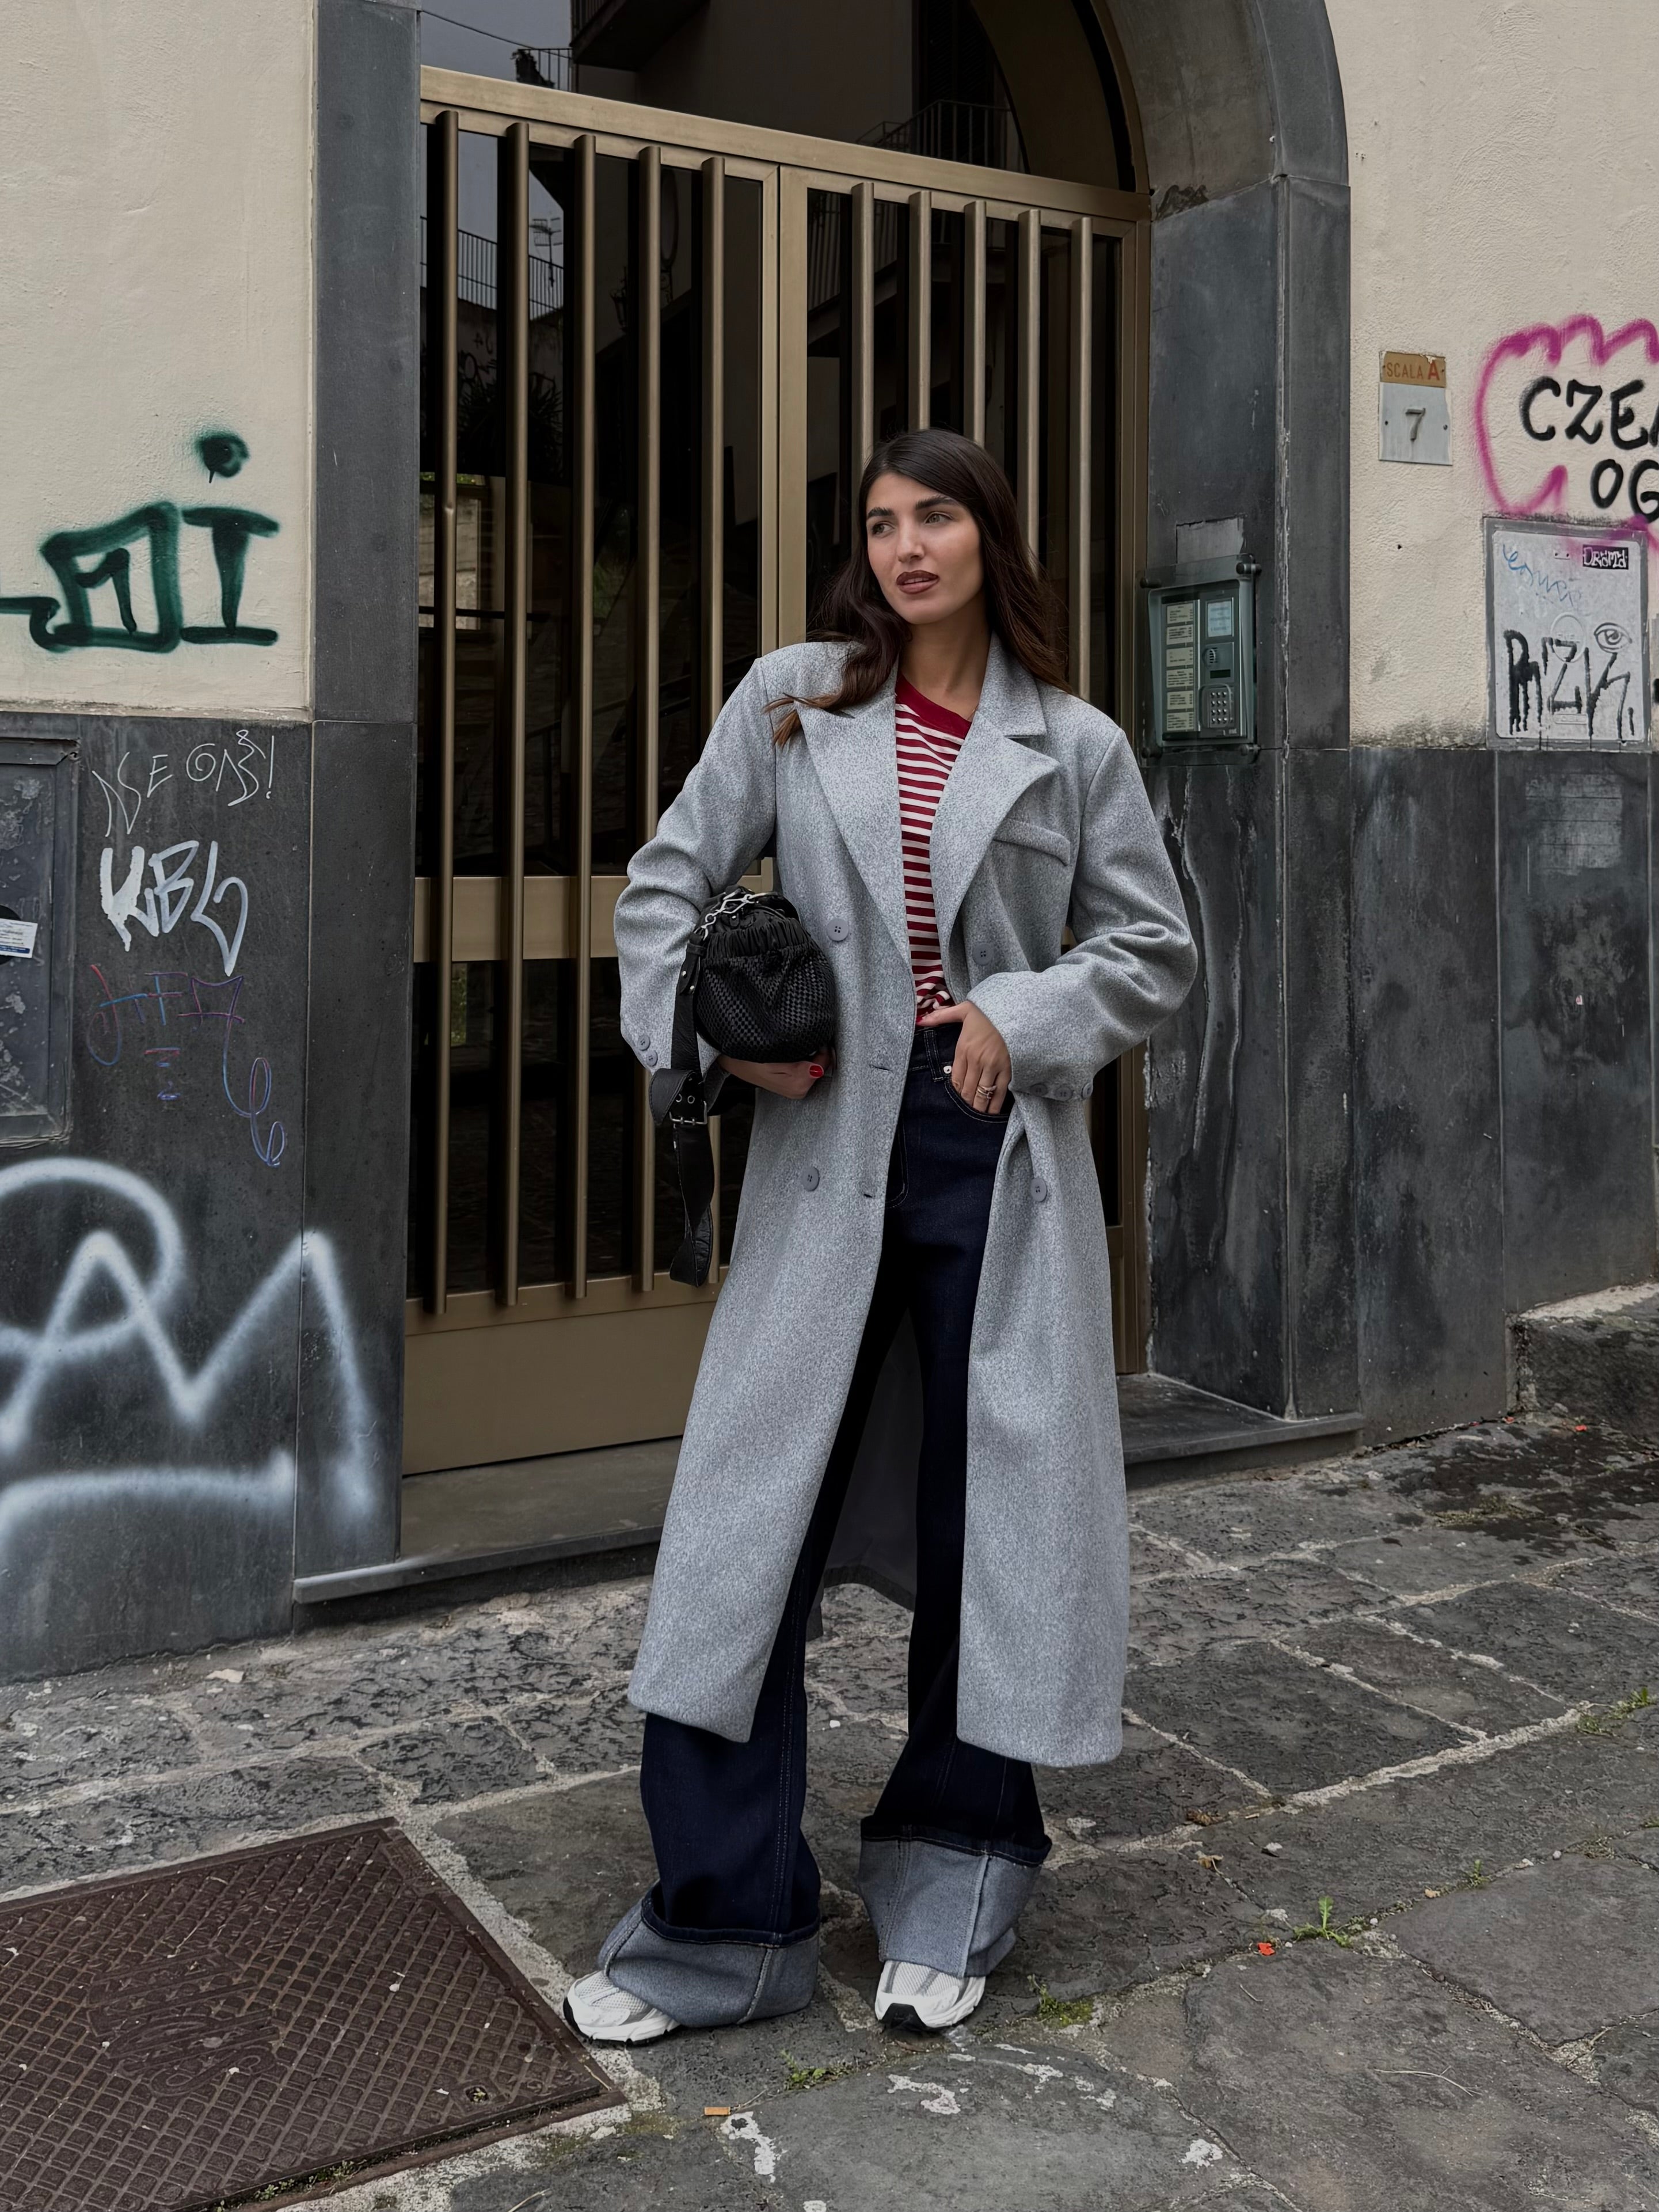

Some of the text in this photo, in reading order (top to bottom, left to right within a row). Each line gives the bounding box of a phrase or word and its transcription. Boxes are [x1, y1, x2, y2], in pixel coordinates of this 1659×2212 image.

[1386, 360, 1440, 381] SCALA A
[1405, 407, 1426, 443] 7
